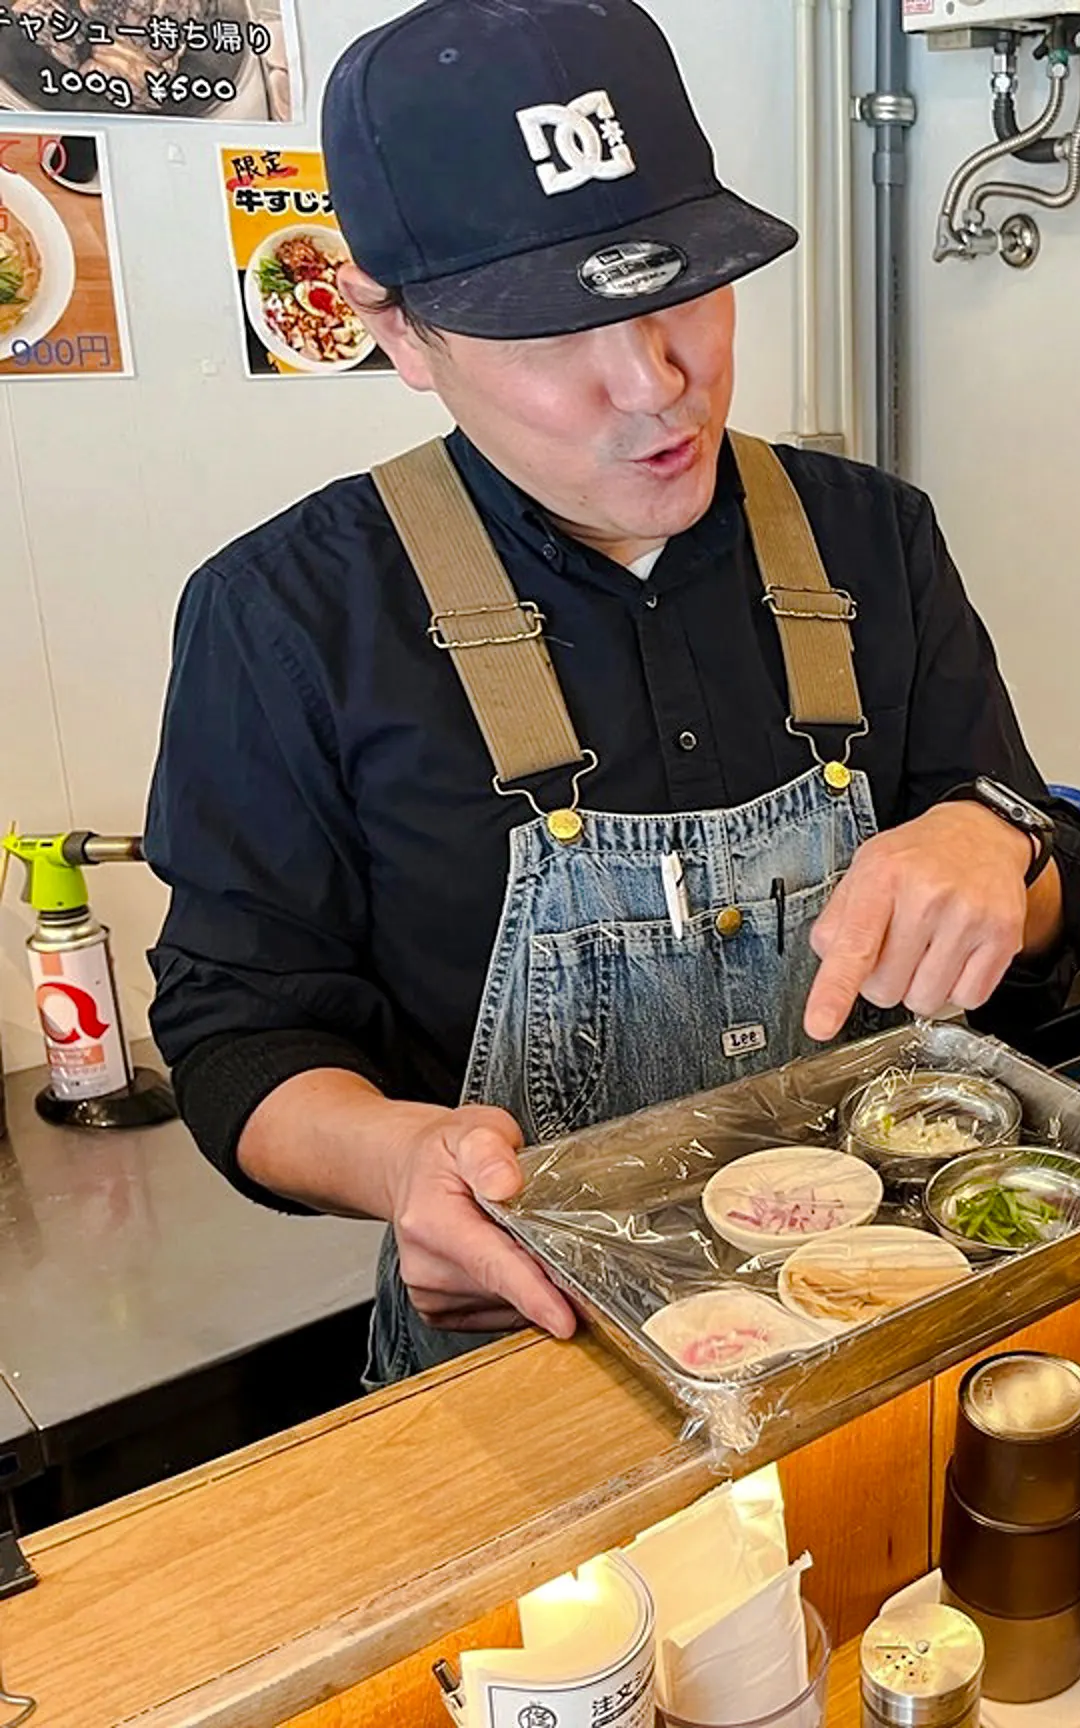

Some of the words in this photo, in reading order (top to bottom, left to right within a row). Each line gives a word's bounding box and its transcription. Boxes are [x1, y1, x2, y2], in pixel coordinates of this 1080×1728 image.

[40, 69, 132, 108] 100g
[147, 72, 236, 101] ¥500
[516, 89, 636, 195] DC
[232, 151, 290, 182] 限定
[12, 336, 112, 367] 900円
[730, 1031, 757, 1047] Lee
